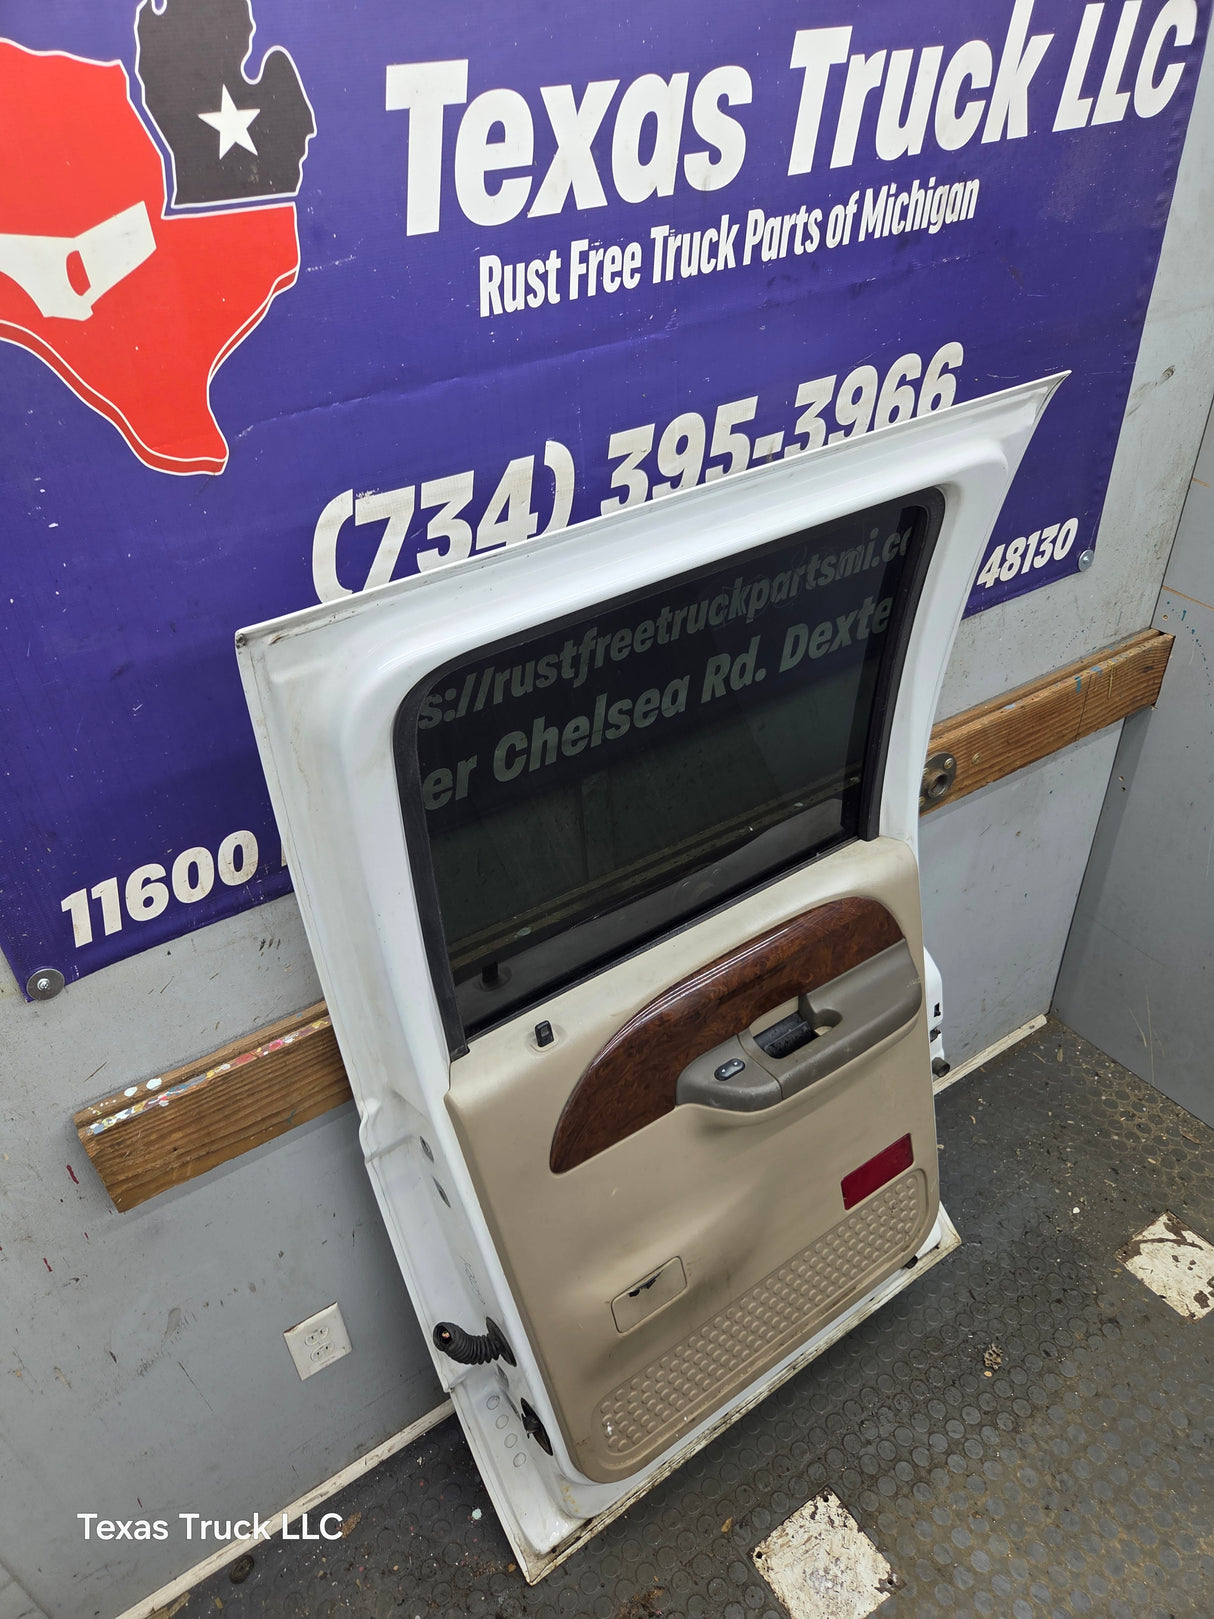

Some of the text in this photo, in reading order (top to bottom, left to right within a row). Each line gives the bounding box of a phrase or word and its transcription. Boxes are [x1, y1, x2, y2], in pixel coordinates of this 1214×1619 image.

[386, 0, 1198, 236] Texas Truck LLC
[479, 177, 980, 317] Rust Free Truck Parts of Michigan
[311, 341, 964, 603] (734) 395-3966
[60, 829, 259, 948] 11600
[492, 674, 691, 782] Chelsea
[701, 636, 768, 705] Rd.
[976, 517, 1079, 588] 48130
